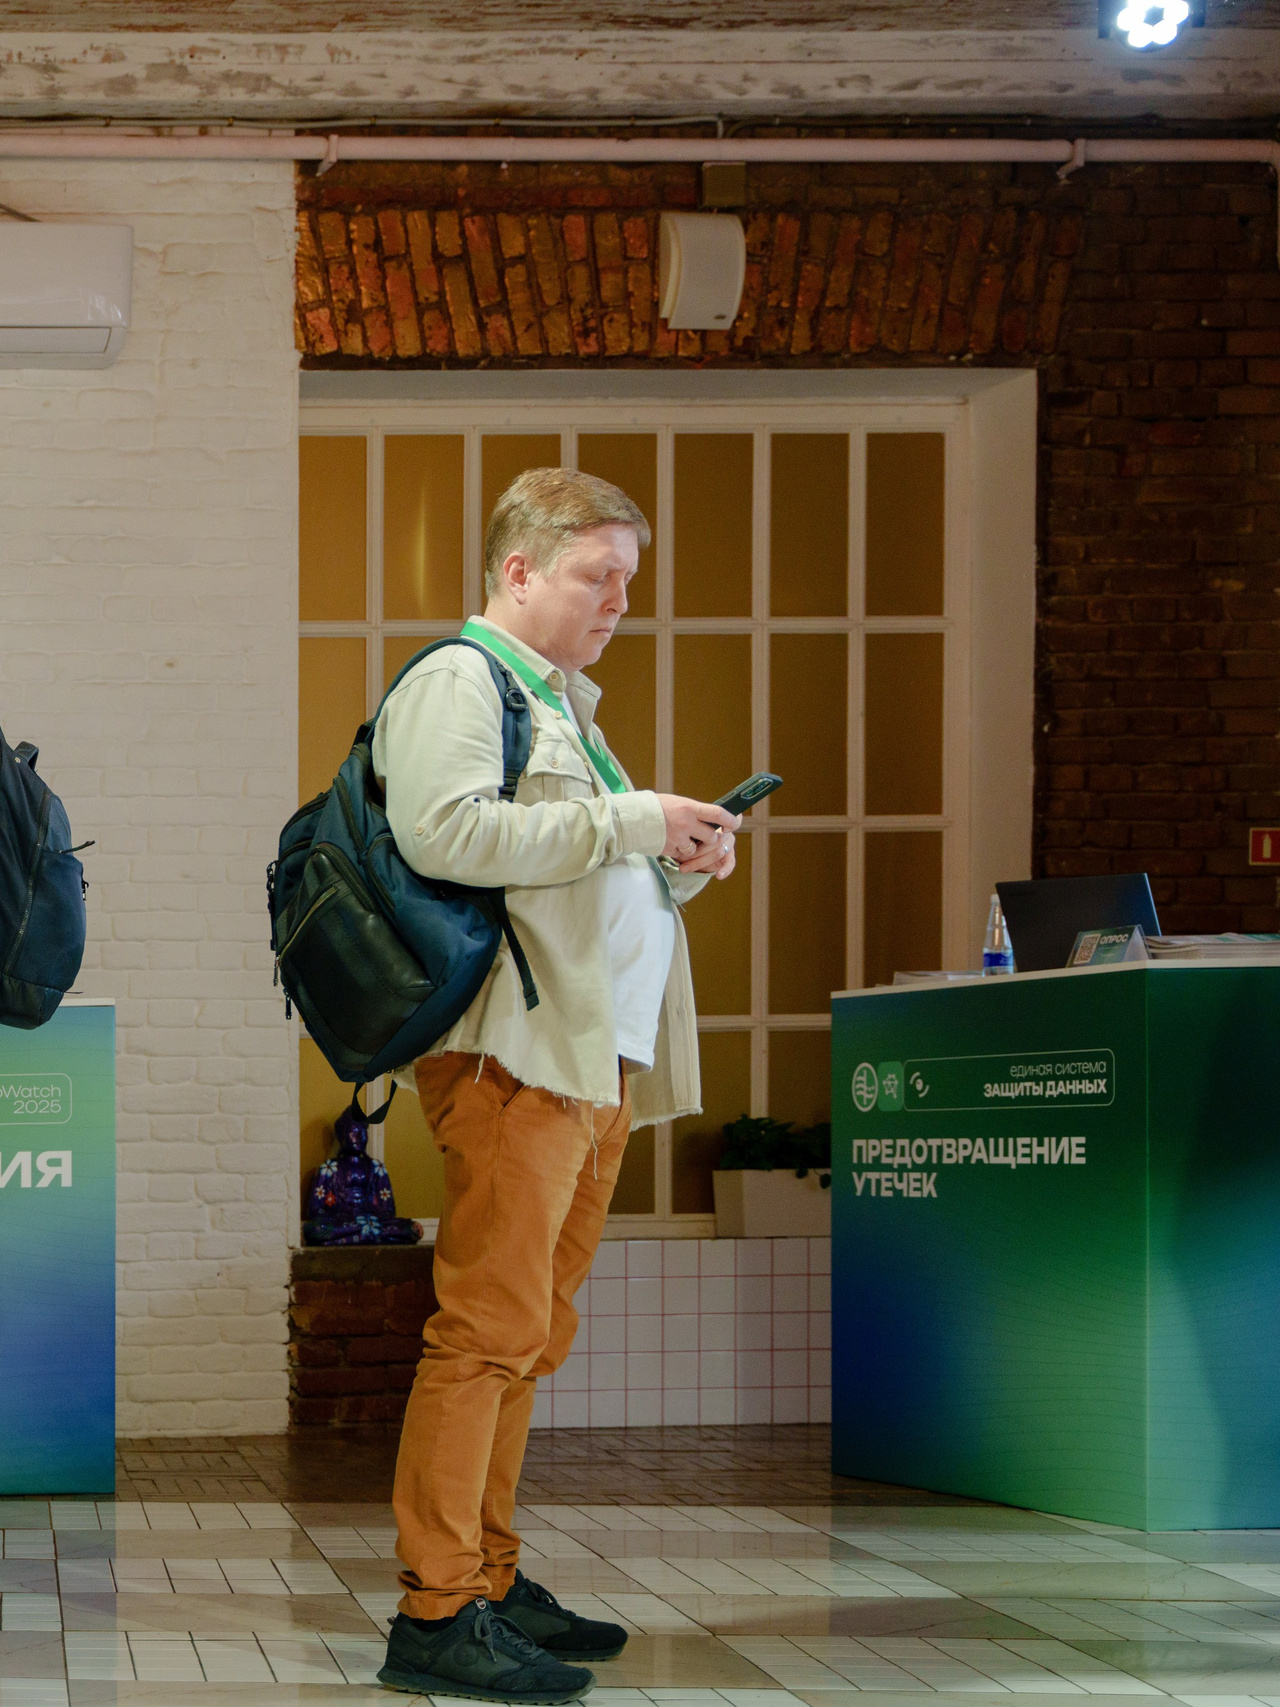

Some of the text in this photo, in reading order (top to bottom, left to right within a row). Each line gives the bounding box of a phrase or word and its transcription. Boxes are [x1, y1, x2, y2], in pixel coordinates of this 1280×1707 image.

[1100, 933, 1129, 945] ОПРОС
[1010, 1060, 1107, 1079] единая система
[983, 1078, 1107, 1099] ЗАЩИТЫ ДАННЫХ
[12, 1099, 62, 1114] 2025
[852, 1136, 1086, 1169] ПРЕДОТВРАЩЕНИЕ
[851, 1171, 938, 1198] УТЕЧЕК
